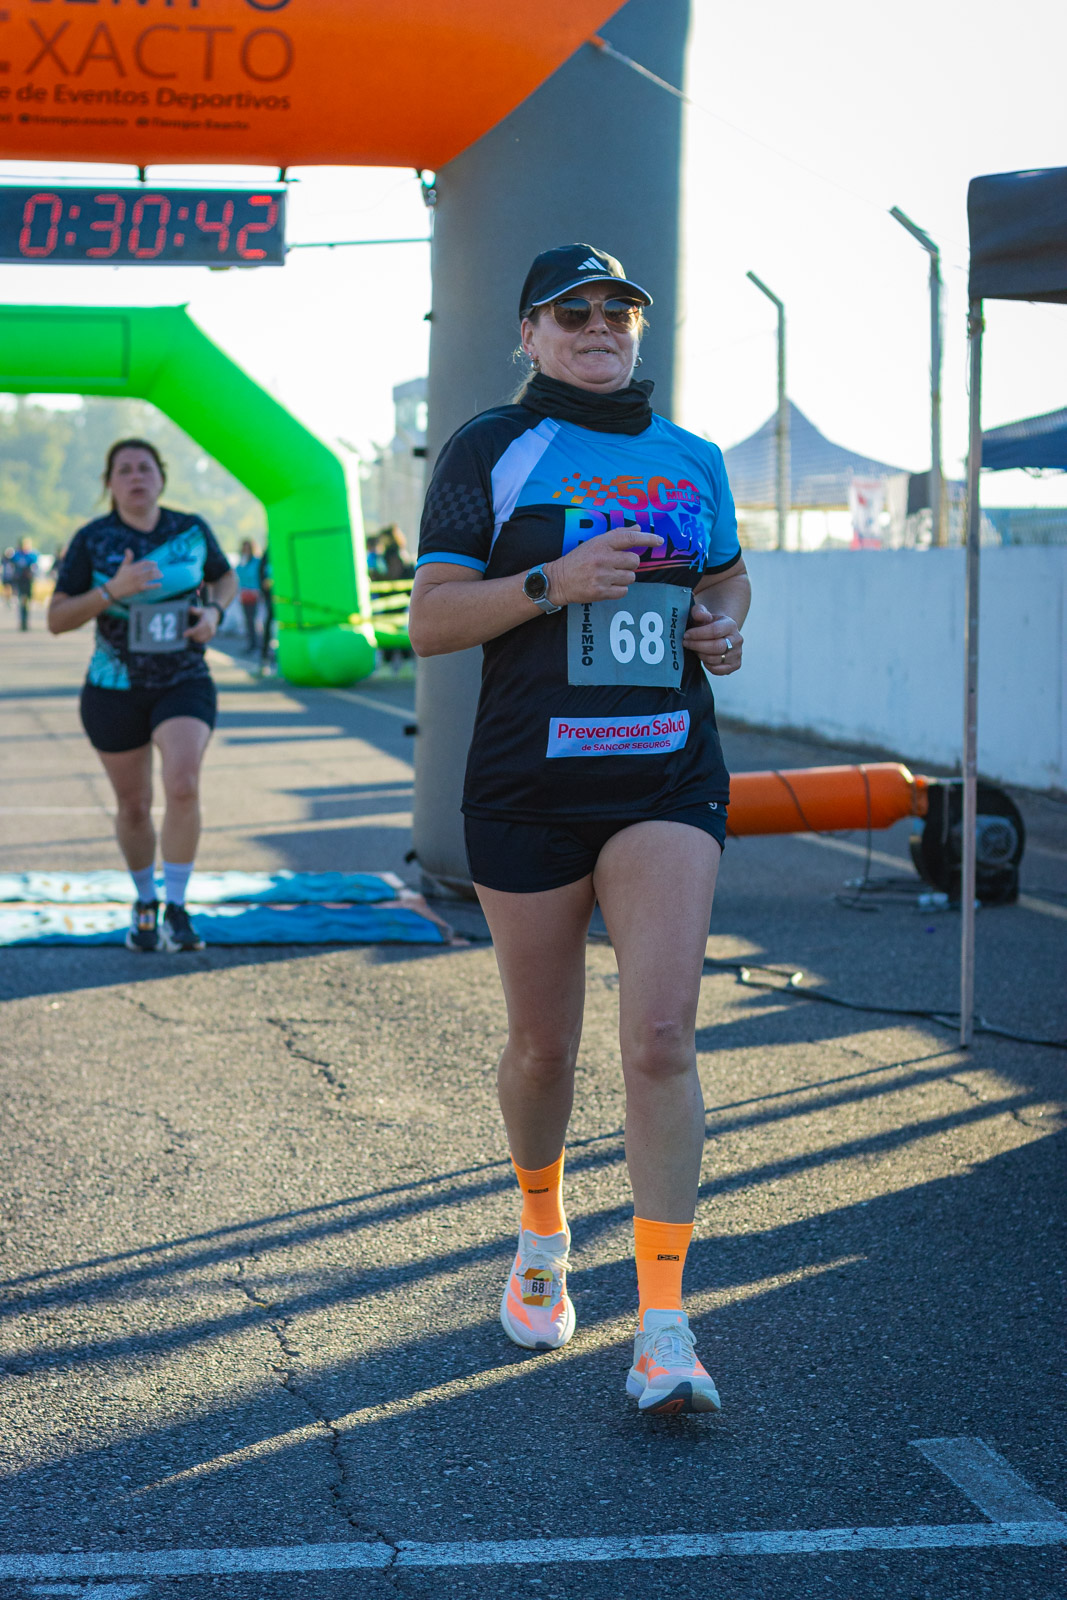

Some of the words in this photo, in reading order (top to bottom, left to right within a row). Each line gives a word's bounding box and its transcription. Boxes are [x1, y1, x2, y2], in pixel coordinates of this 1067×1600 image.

[16, 82, 48, 103] de
[54, 84, 149, 106] Eventos
[156, 87, 291, 111] Deportivos
[19, 193, 279, 259] 0:30:42
[148, 612, 178, 642] 42
[581, 603, 594, 666] TIEMPO
[609, 610, 665, 665] 68
[669, 607, 680, 671] EXACTO
[557, 723, 650, 739] Prevención
[652, 715, 686, 736] Salud
[593, 742, 630, 751] SANCOR
[631, 740, 671, 750] SEGUROS
[532, 1281, 545, 1293] 68
